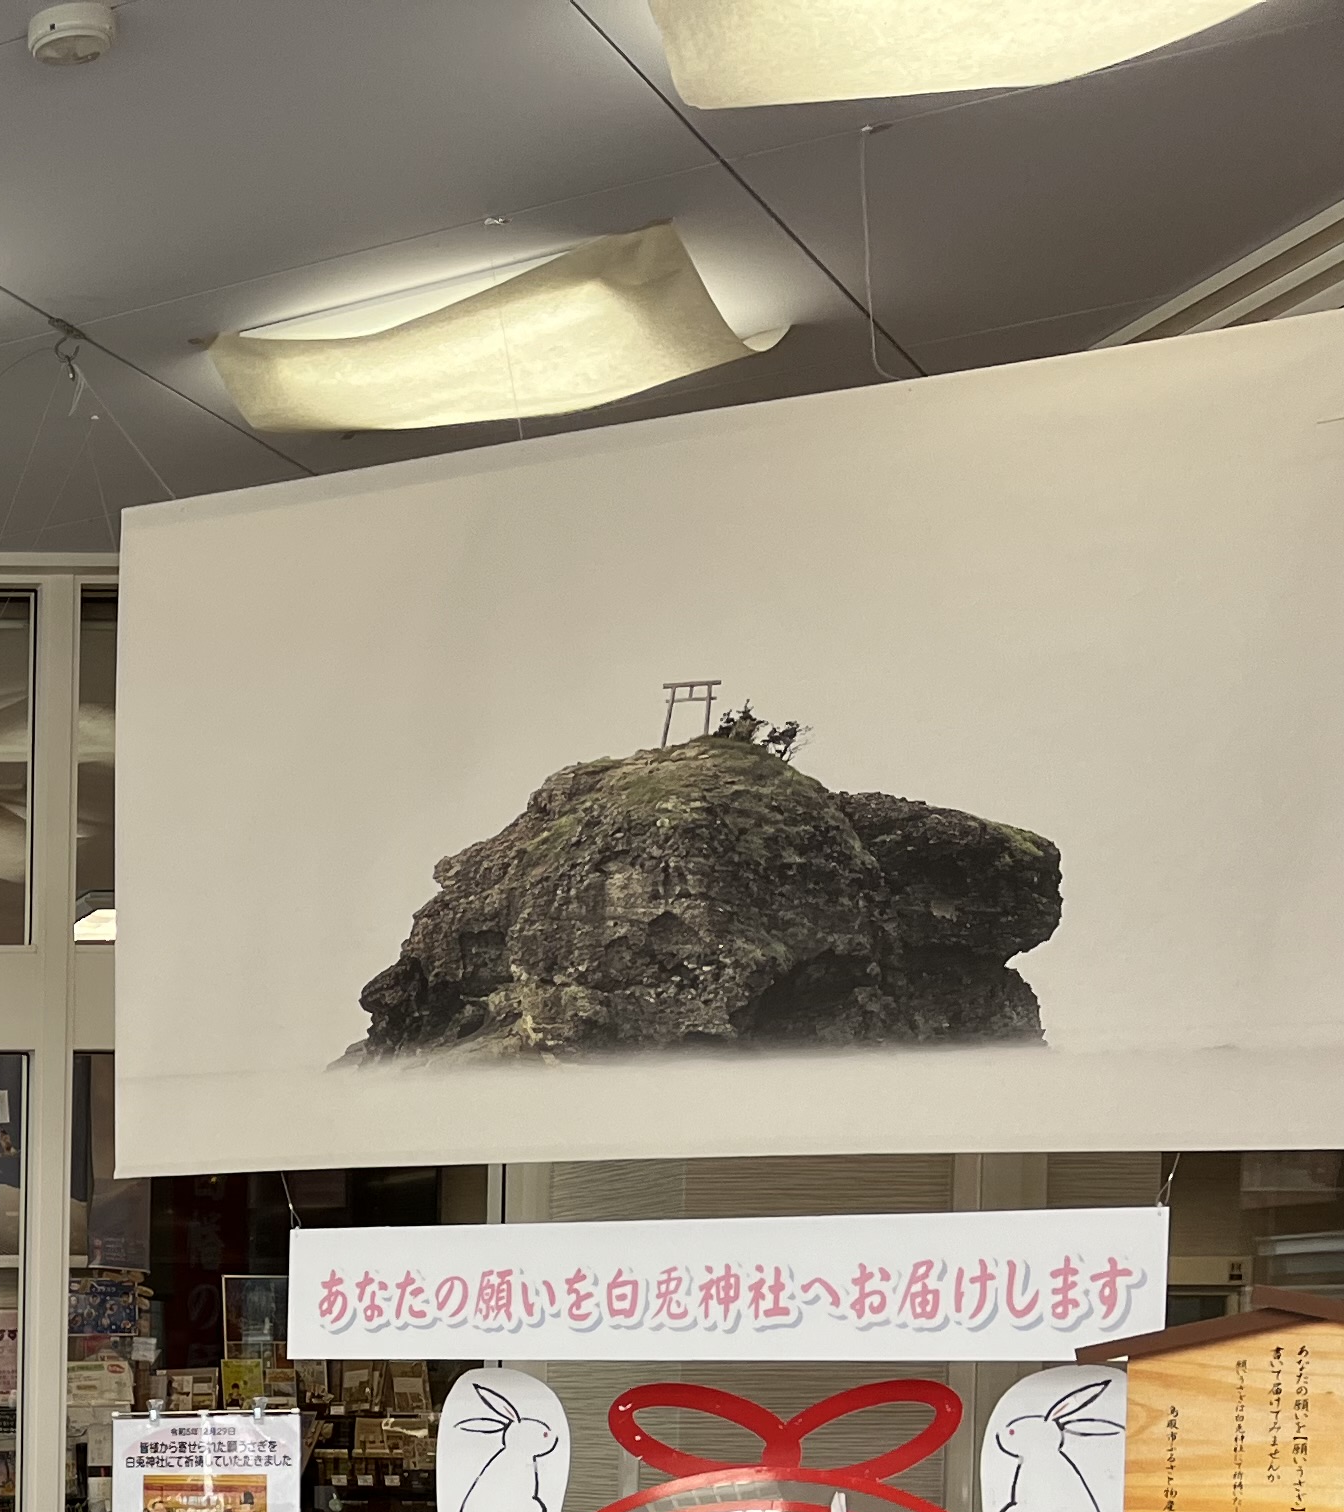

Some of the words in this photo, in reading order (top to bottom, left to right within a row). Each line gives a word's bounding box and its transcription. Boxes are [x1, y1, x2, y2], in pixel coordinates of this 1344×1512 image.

[315, 1254, 1140, 1330] あなたの願いを白兎神社へお届けします
[1267, 1346, 1285, 1484] 書いて届けてみませんか
